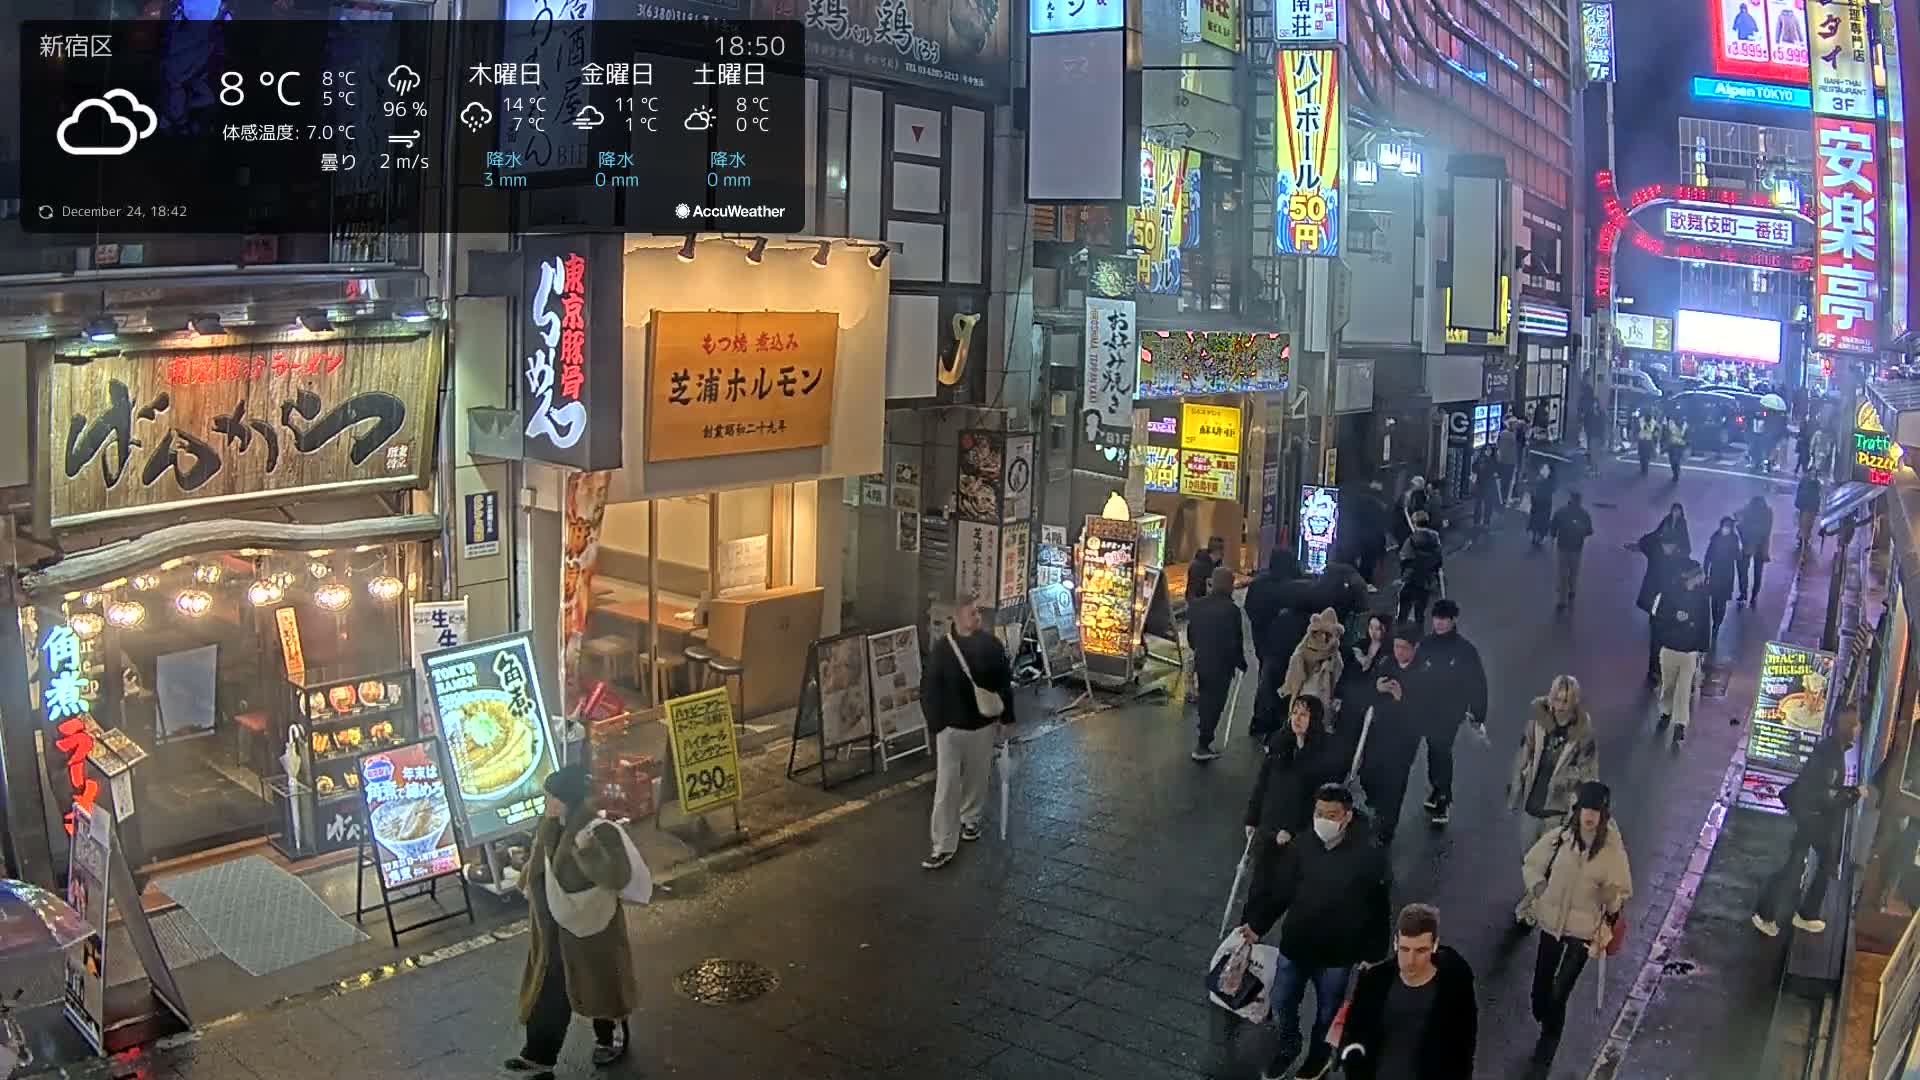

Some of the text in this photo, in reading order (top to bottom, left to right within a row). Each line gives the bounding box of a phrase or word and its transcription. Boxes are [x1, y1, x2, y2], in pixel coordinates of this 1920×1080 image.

[1714, 82, 1793, 101] Alpen TOKYO
[1832, 97, 1855, 111] 3F
[1295, 55, 1320, 190] ハイボール
[1160, 152, 1173, 289] ハイボール
[1670, 211, 1789, 242] 歌舞伎町一番街
[1819, 126, 1875, 330] 安楽亭
[560, 253, 585, 400] 東京豚骨
[702, 331, 799, 354] もつ焼 煮込み
[1817, 332, 1836, 347] 2F
[669, 365, 823, 405] 芝浦ホルモン
[1102, 310, 1132, 415] お好み焼き
[65, 378, 406, 493] ばんから
[431, 608, 449, 628] 生
[42, 625, 90, 721] 角煮
[431, 661, 476, 681] TOKYO
[495, 652, 533, 718] 角煮
